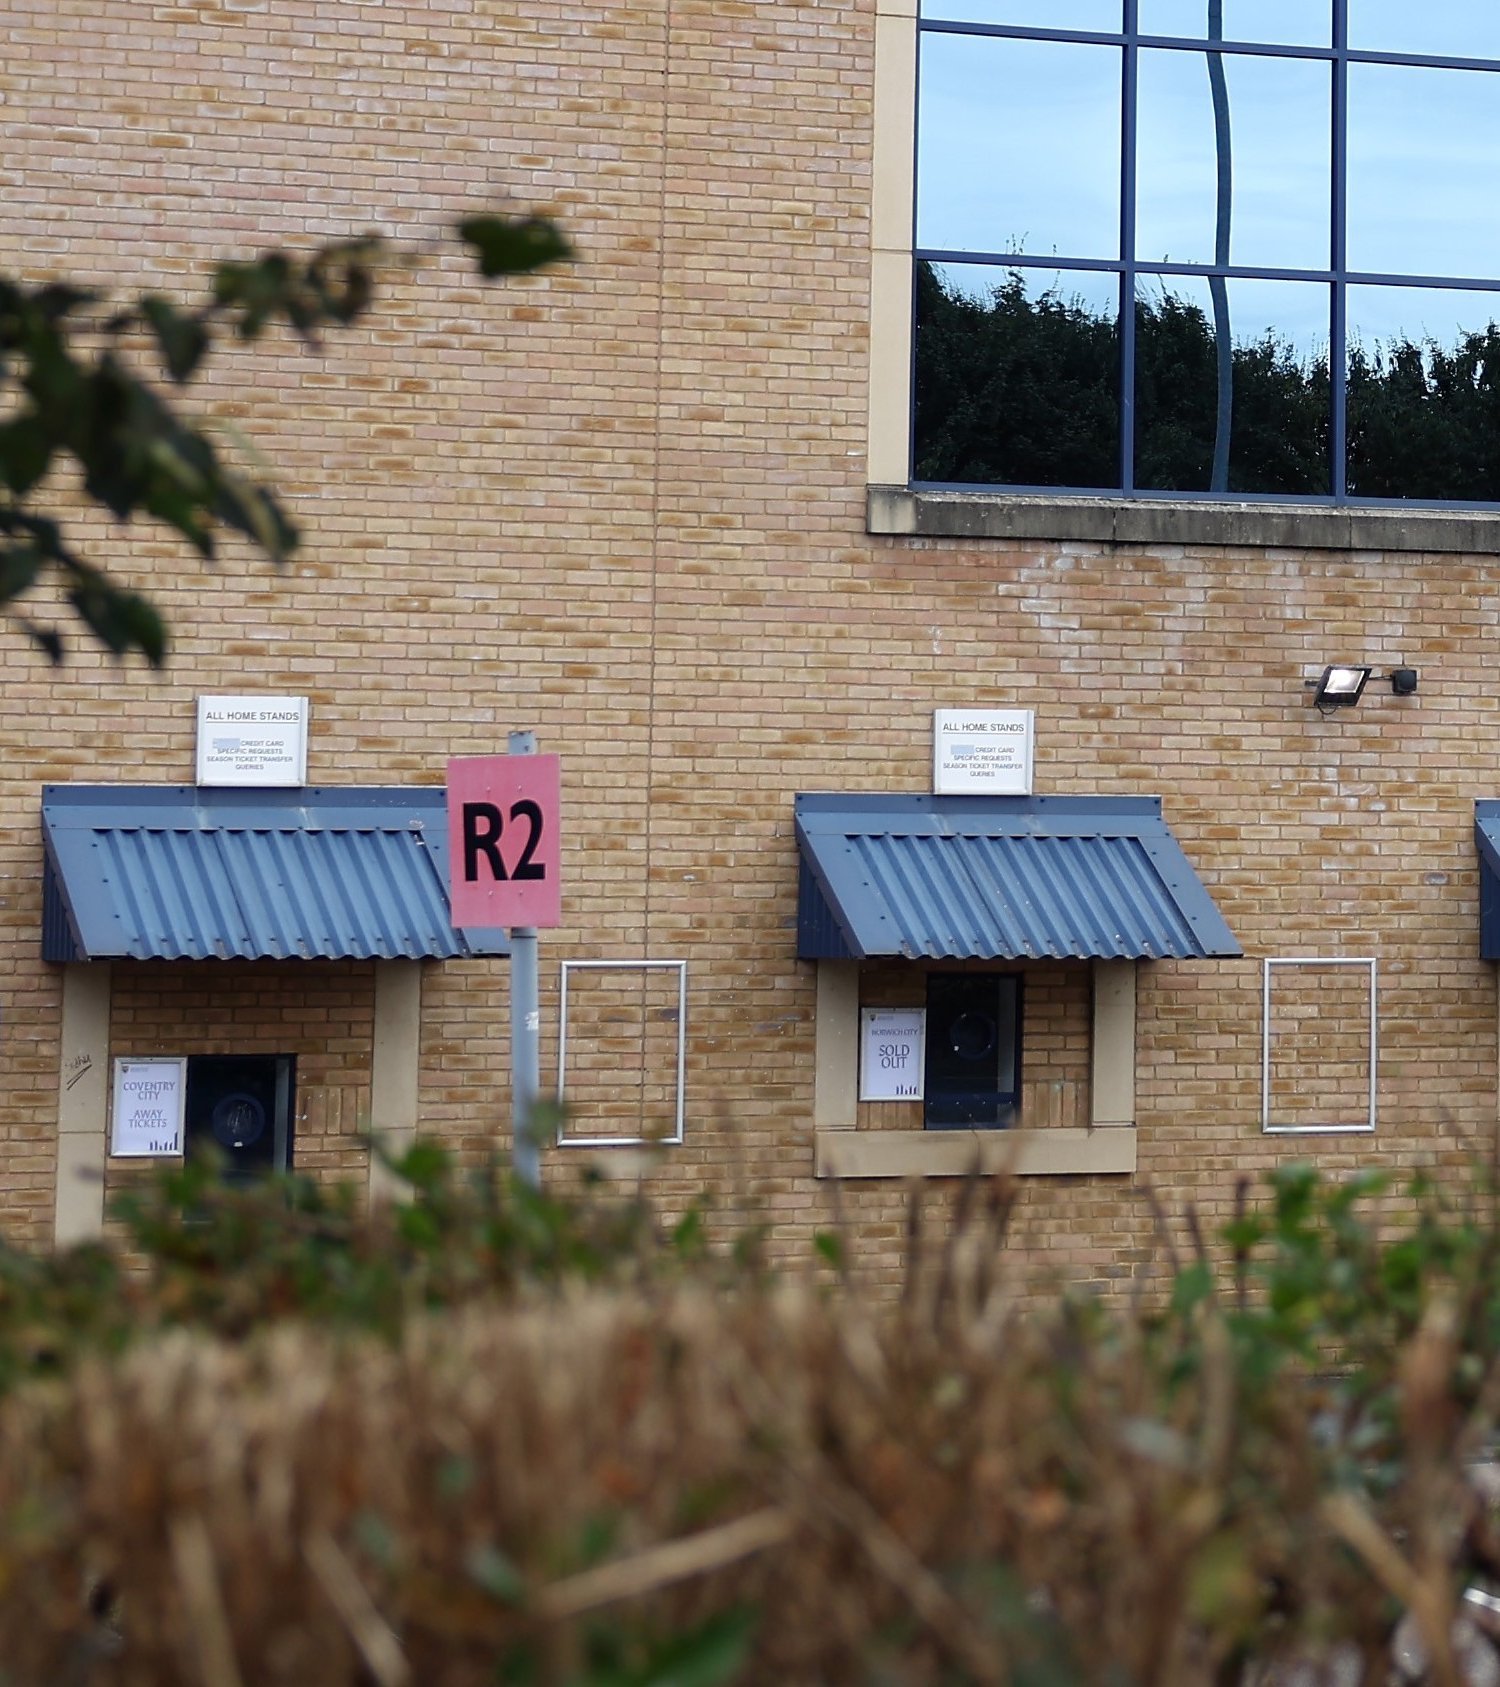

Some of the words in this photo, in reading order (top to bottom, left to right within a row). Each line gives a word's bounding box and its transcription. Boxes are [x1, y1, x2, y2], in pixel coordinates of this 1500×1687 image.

[206, 712, 224, 721] ALL
[227, 712, 257, 721] HOME
[260, 712, 300, 721] STANDS
[943, 723, 959, 732] ALL
[962, 723, 988, 732] HOME
[990, 723, 1024, 732] STANDS
[463, 799, 545, 881] R2
[879, 1045, 910, 1056] SOLD
[881, 1057, 907, 1068] OUT
[123, 1081, 176, 1091] COVENTRY
[138, 1091, 160, 1100] CITY
[133, 1110, 163, 1119] AWAY
[129, 1119, 168, 1128] TICKETS
